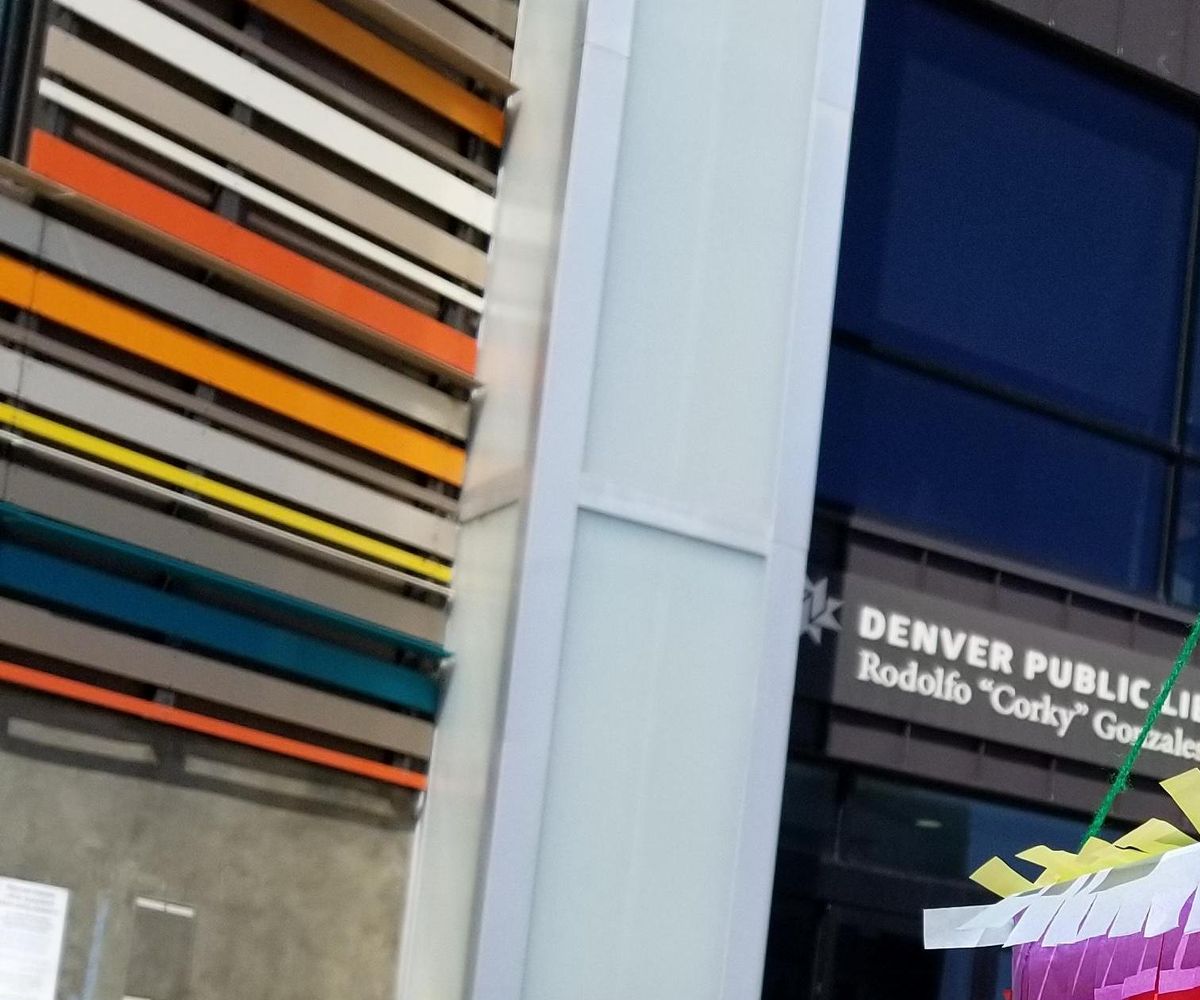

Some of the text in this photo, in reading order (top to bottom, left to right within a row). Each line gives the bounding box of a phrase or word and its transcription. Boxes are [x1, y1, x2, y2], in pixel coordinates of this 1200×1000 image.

[856, 649, 973, 706] Rodolfo
[858, 605, 1014, 675] DENVER
[1023, 650, 1152, 710] PUBLIC
